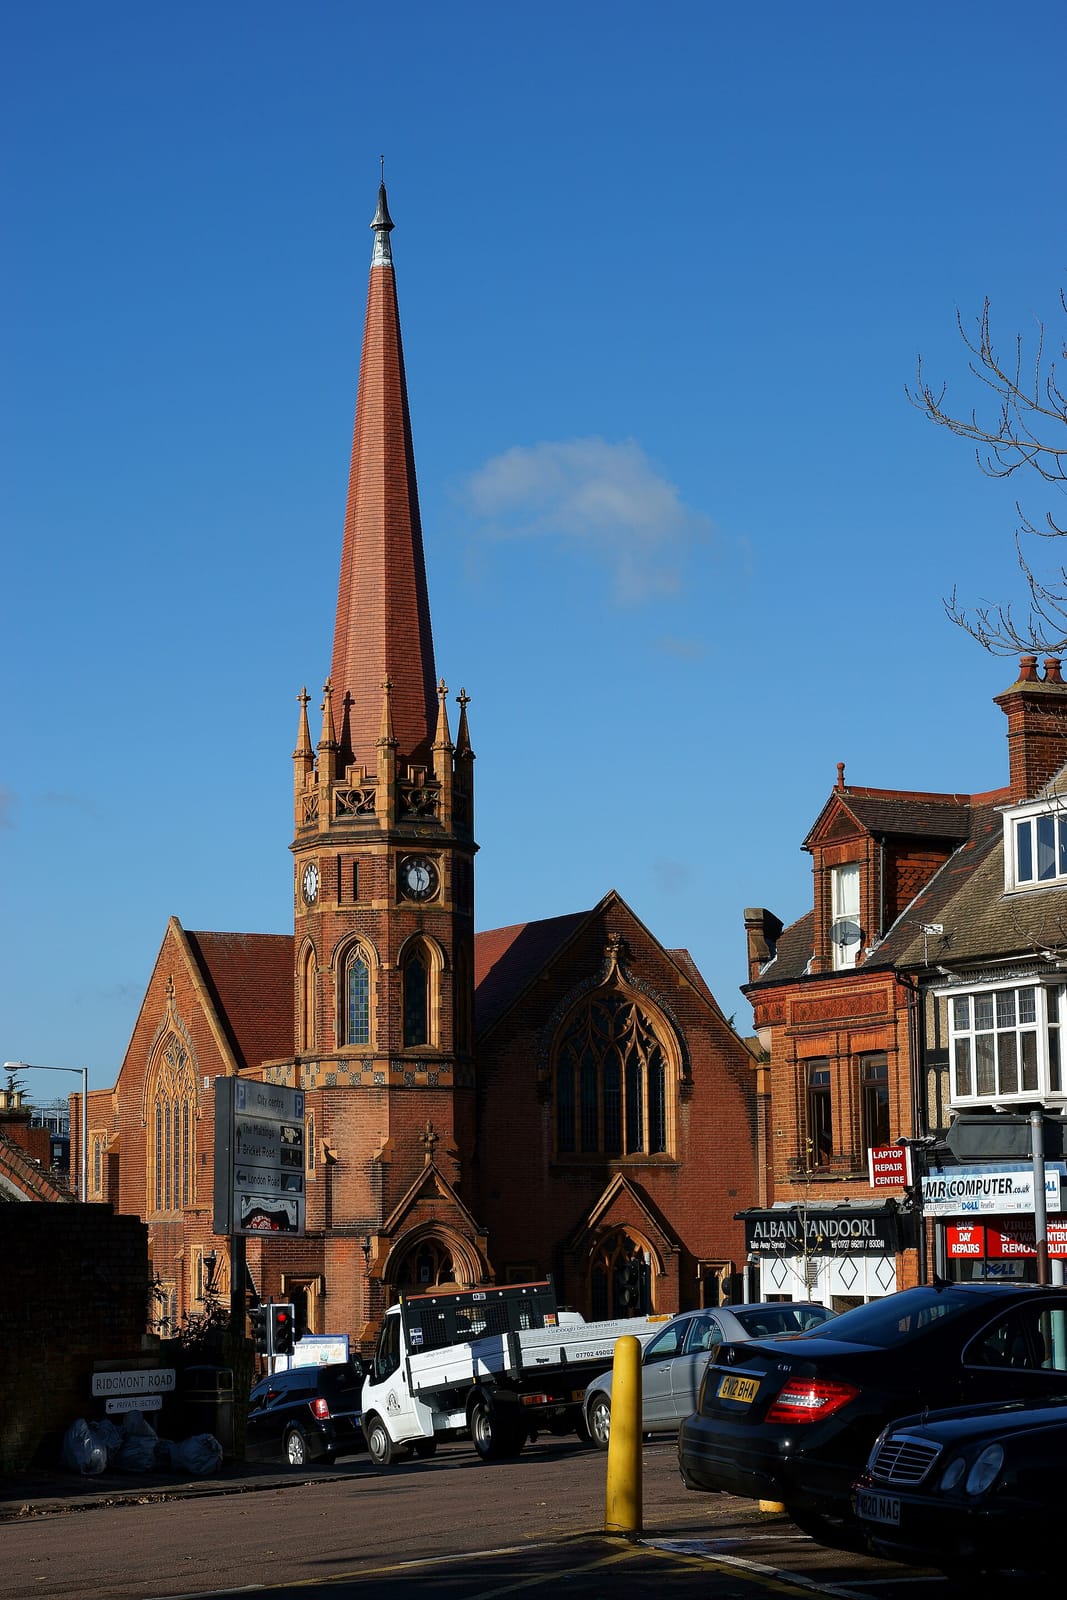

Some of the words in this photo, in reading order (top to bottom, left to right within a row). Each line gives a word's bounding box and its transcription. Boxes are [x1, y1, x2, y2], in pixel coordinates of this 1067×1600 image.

[257, 1094, 267, 1107] City
[873, 1150, 903, 1159] LAPTOP
[874, 1162, 903, 1172] REPAIR
[247, 1173, 266, 1185] London
[267, 1175, 280, 1187] Road
[875, 1175, 905, 1185] CENTRE
[925, 1181, 946, 1198] MR
[961, 1201, 979, 1210] DELL
[753, 1220, 797, 1238] ALBAN
[803, 1219, 876, 1238] TANDOORI
[956, 1221, 974, 1231] SAME
[1003, 1220, 1034, 1231] VIRUS
[959, 1232, 971, 1242] DAY
[951, 1243, 980, 1254] REPAIRS
[981, 1263, 1016, 1275] DELL
[576, 1351, 594, 1359] 07702
[96, 1376, 145, 1390] RIDGMONT
[149, 1374, 173, 1387] ROAD
[738, 1380, 755, 1399] BHA
[116, 1400, 137, 1409] PRIVATE
[880, 1497, 899, 1520] NAG
